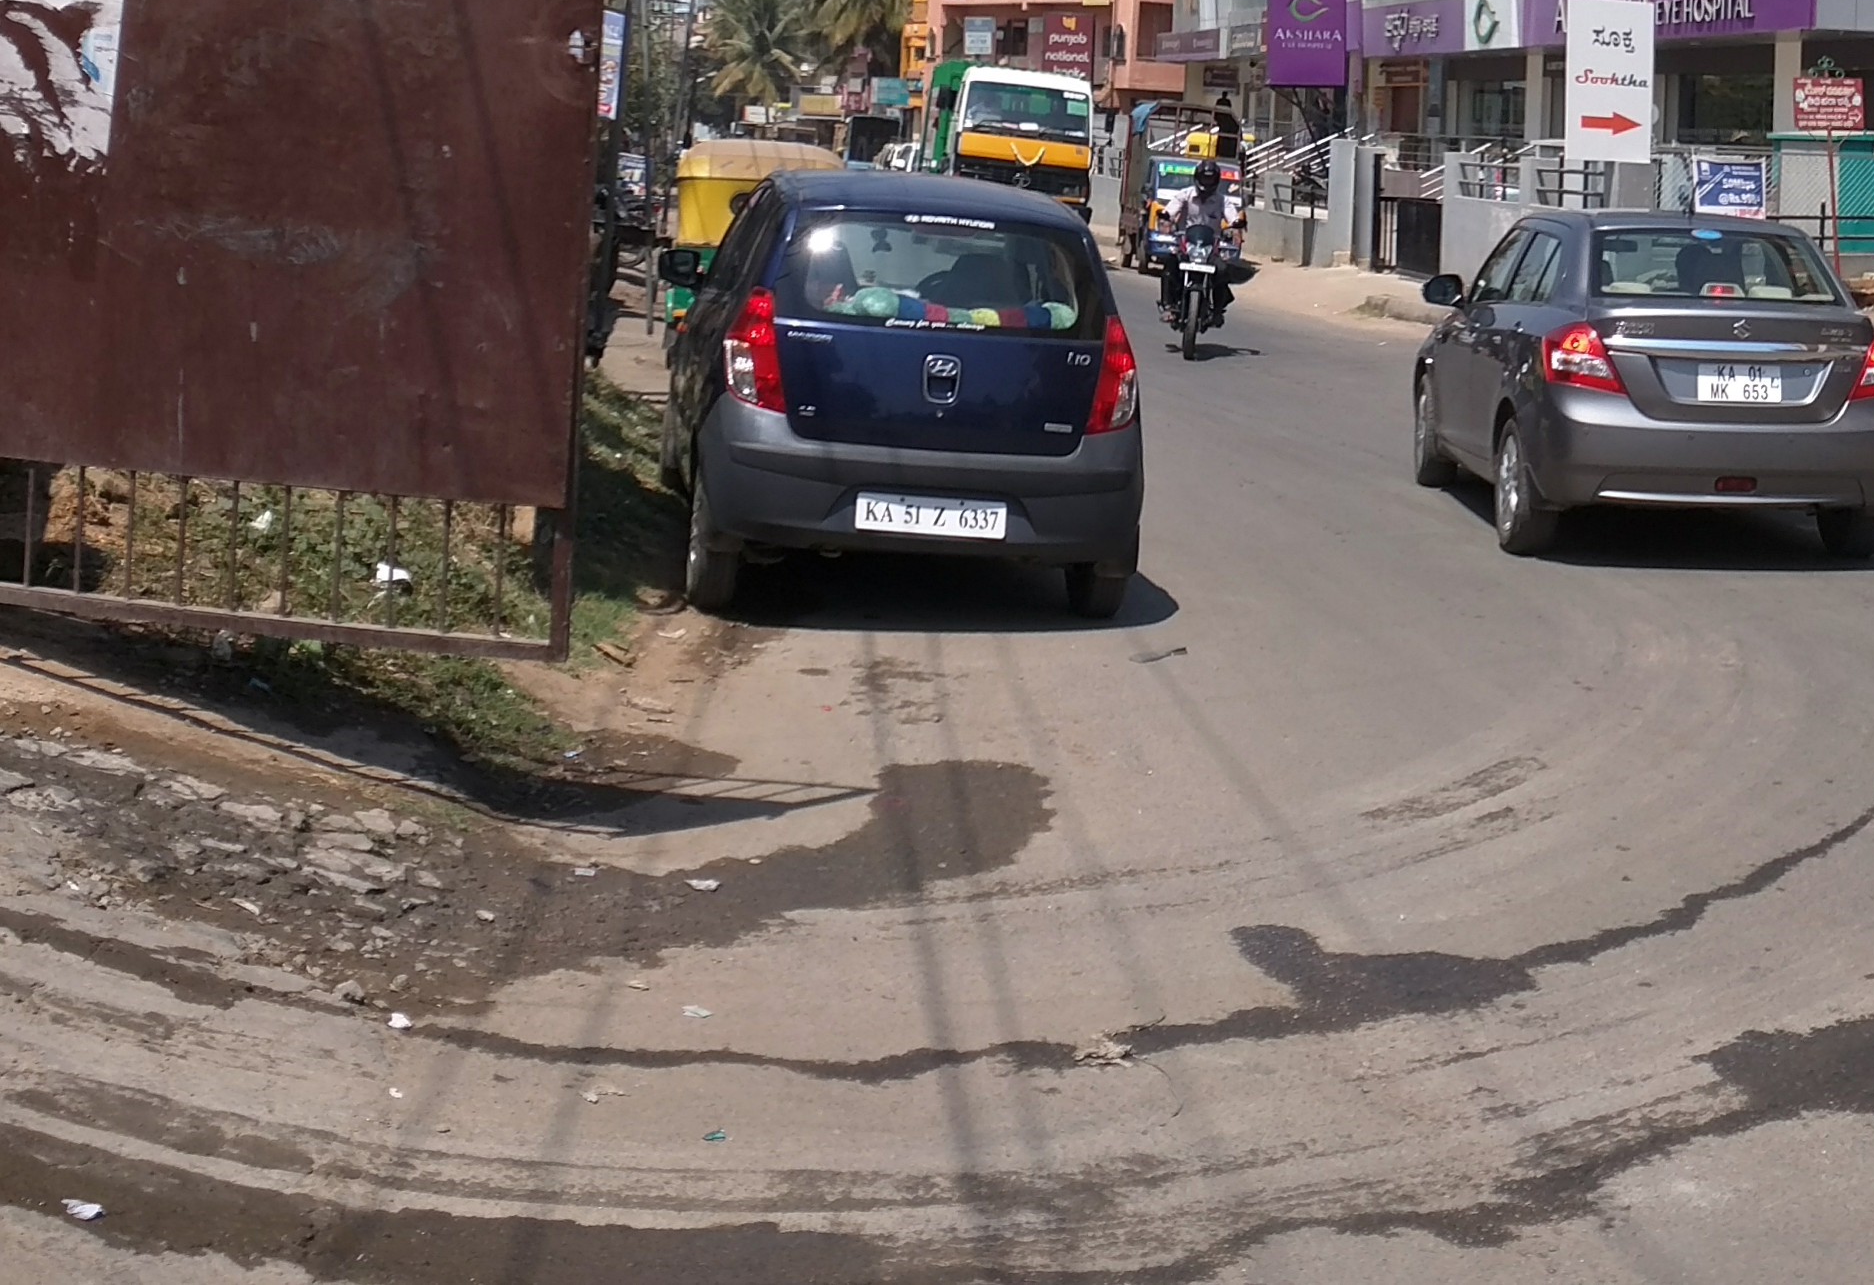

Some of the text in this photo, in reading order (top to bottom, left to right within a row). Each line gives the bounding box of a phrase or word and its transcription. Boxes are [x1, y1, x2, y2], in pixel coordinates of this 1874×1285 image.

[1048, 32, 1088, 48] punjab
[1274, 27, 1343, 42] AKSHARA
[1045, 50, 1090, 64] national
[1716, 365, 1763, 382] KA 01
[1710, 383, 1769, 401] MK 653
[865, 501, 1000, 531] KA 51 Z 6337
